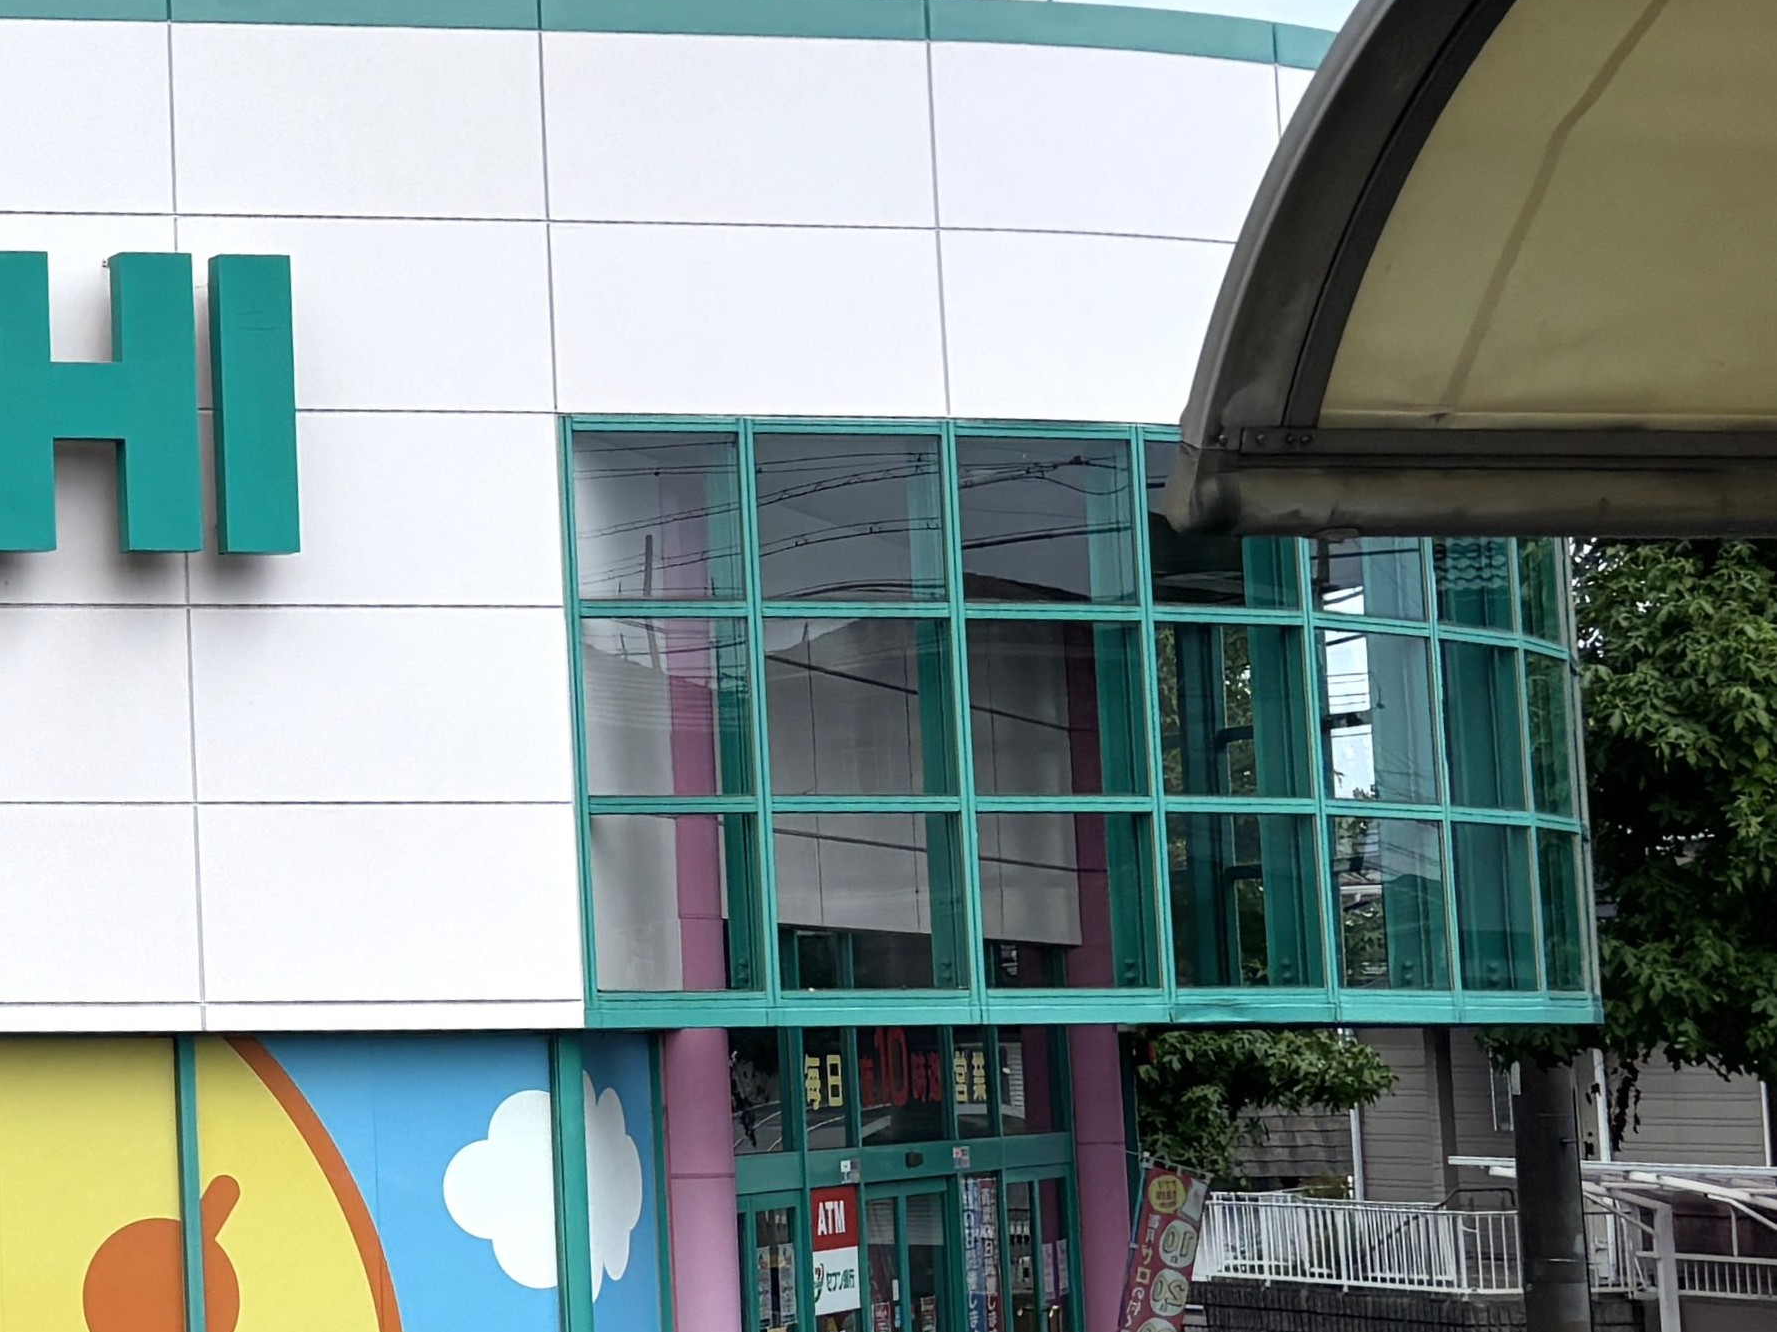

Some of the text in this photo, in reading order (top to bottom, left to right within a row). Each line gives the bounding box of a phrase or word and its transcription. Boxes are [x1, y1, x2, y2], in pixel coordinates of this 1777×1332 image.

[804, 1053, 843, 1110] 毎日
[953, 1050, 987, 1103] 営業
[817, 1200, 846, 1235] ATM
